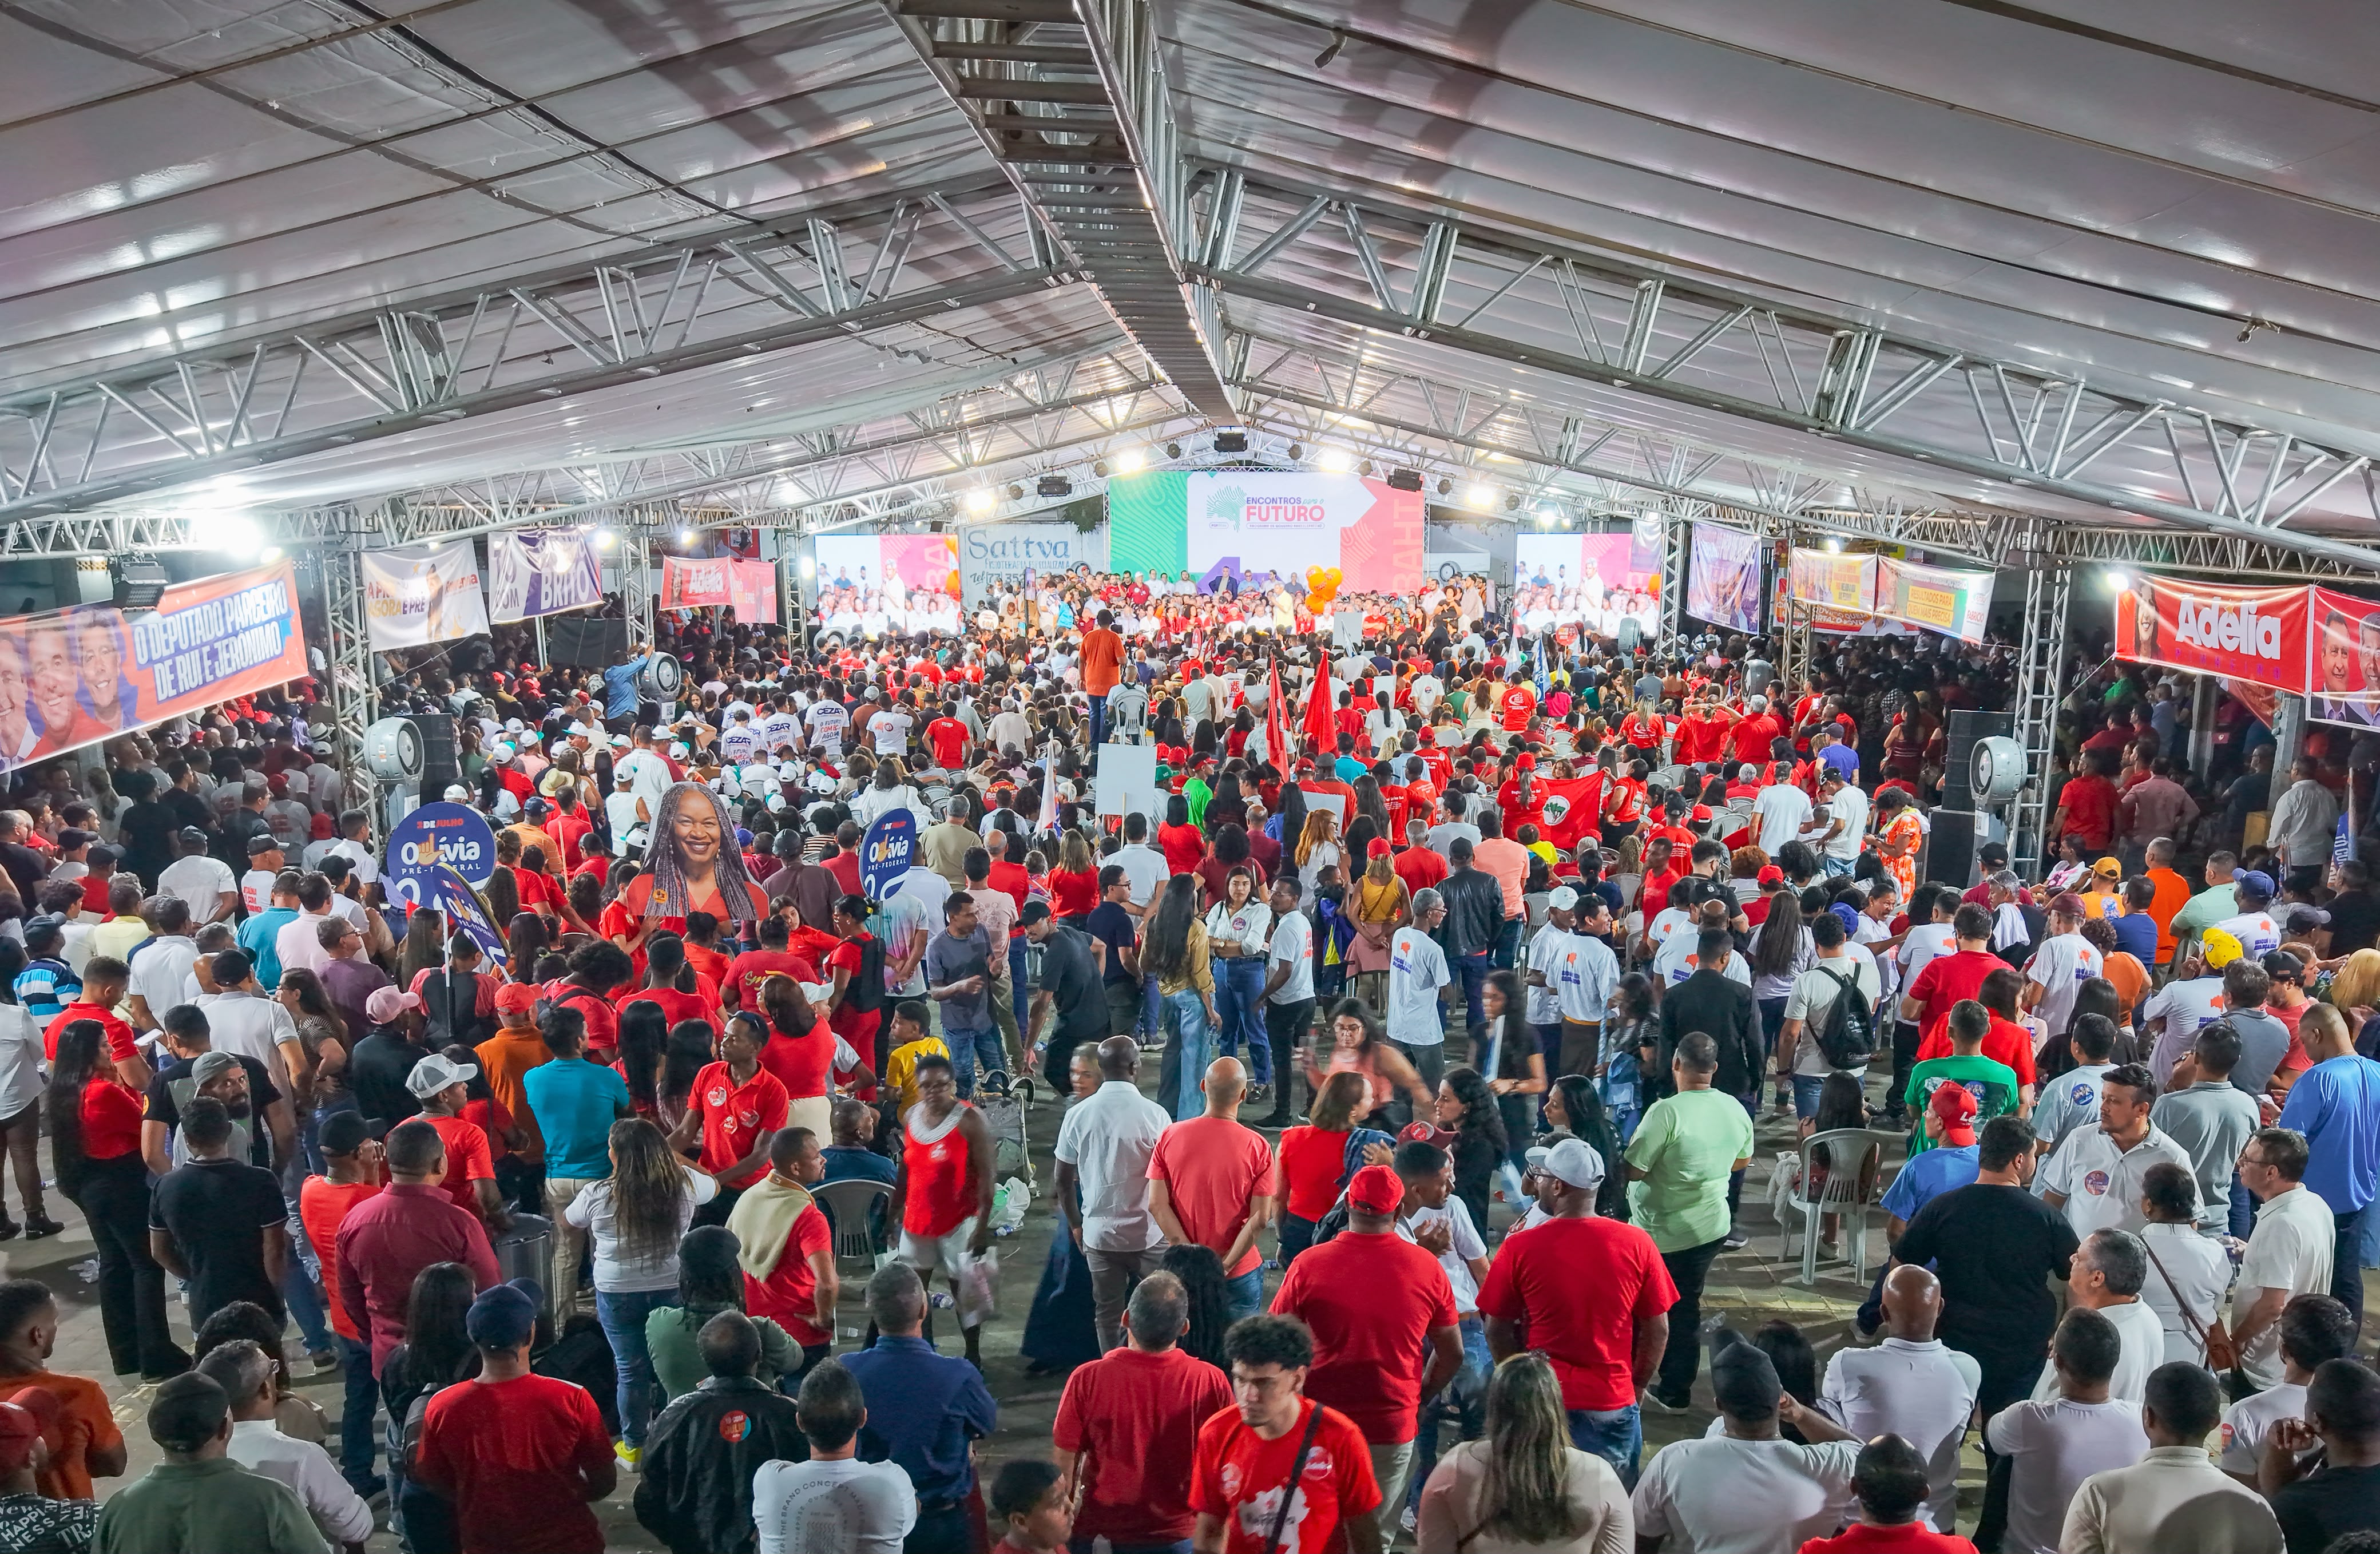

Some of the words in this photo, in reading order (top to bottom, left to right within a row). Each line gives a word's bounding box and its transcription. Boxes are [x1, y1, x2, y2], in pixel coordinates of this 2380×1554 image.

[1247, 497, 1302, 505] ENCONTROS
[1247, 505, 1325, 522] FUTURO
[968, 529, 1071, 559] Sattva
[1907, 604, 1919, 616] QUEM
[1920, 607, 1931, 619] MAIS
[1911, 589, 1939, 604] RESULTADOS
[1939, 594, 1952, 607] PARA
[134, 626, 149, 664] O
[148, 601, 225, 661] DEPUTADO
[224, 580, 288, 633] PARCEIRO
[154, 659, 177, 701] DE
[176, 649, 203, 693] RUI
[202, 645, 213, 683] E
[213, 621, 282, 678] JERÔNIMO
[2175, 648, 2280, 681] PINHEIRO
[868, 858, 906, 871] PRÉ-FEDERAL
[782, 1488, 801, 1517] BRAND
[803, 1480, 849, 1492] CONCEPT
[1, 1508, 45, 1542] HAPPI
[10, 1517, 55, 1552] NESS
